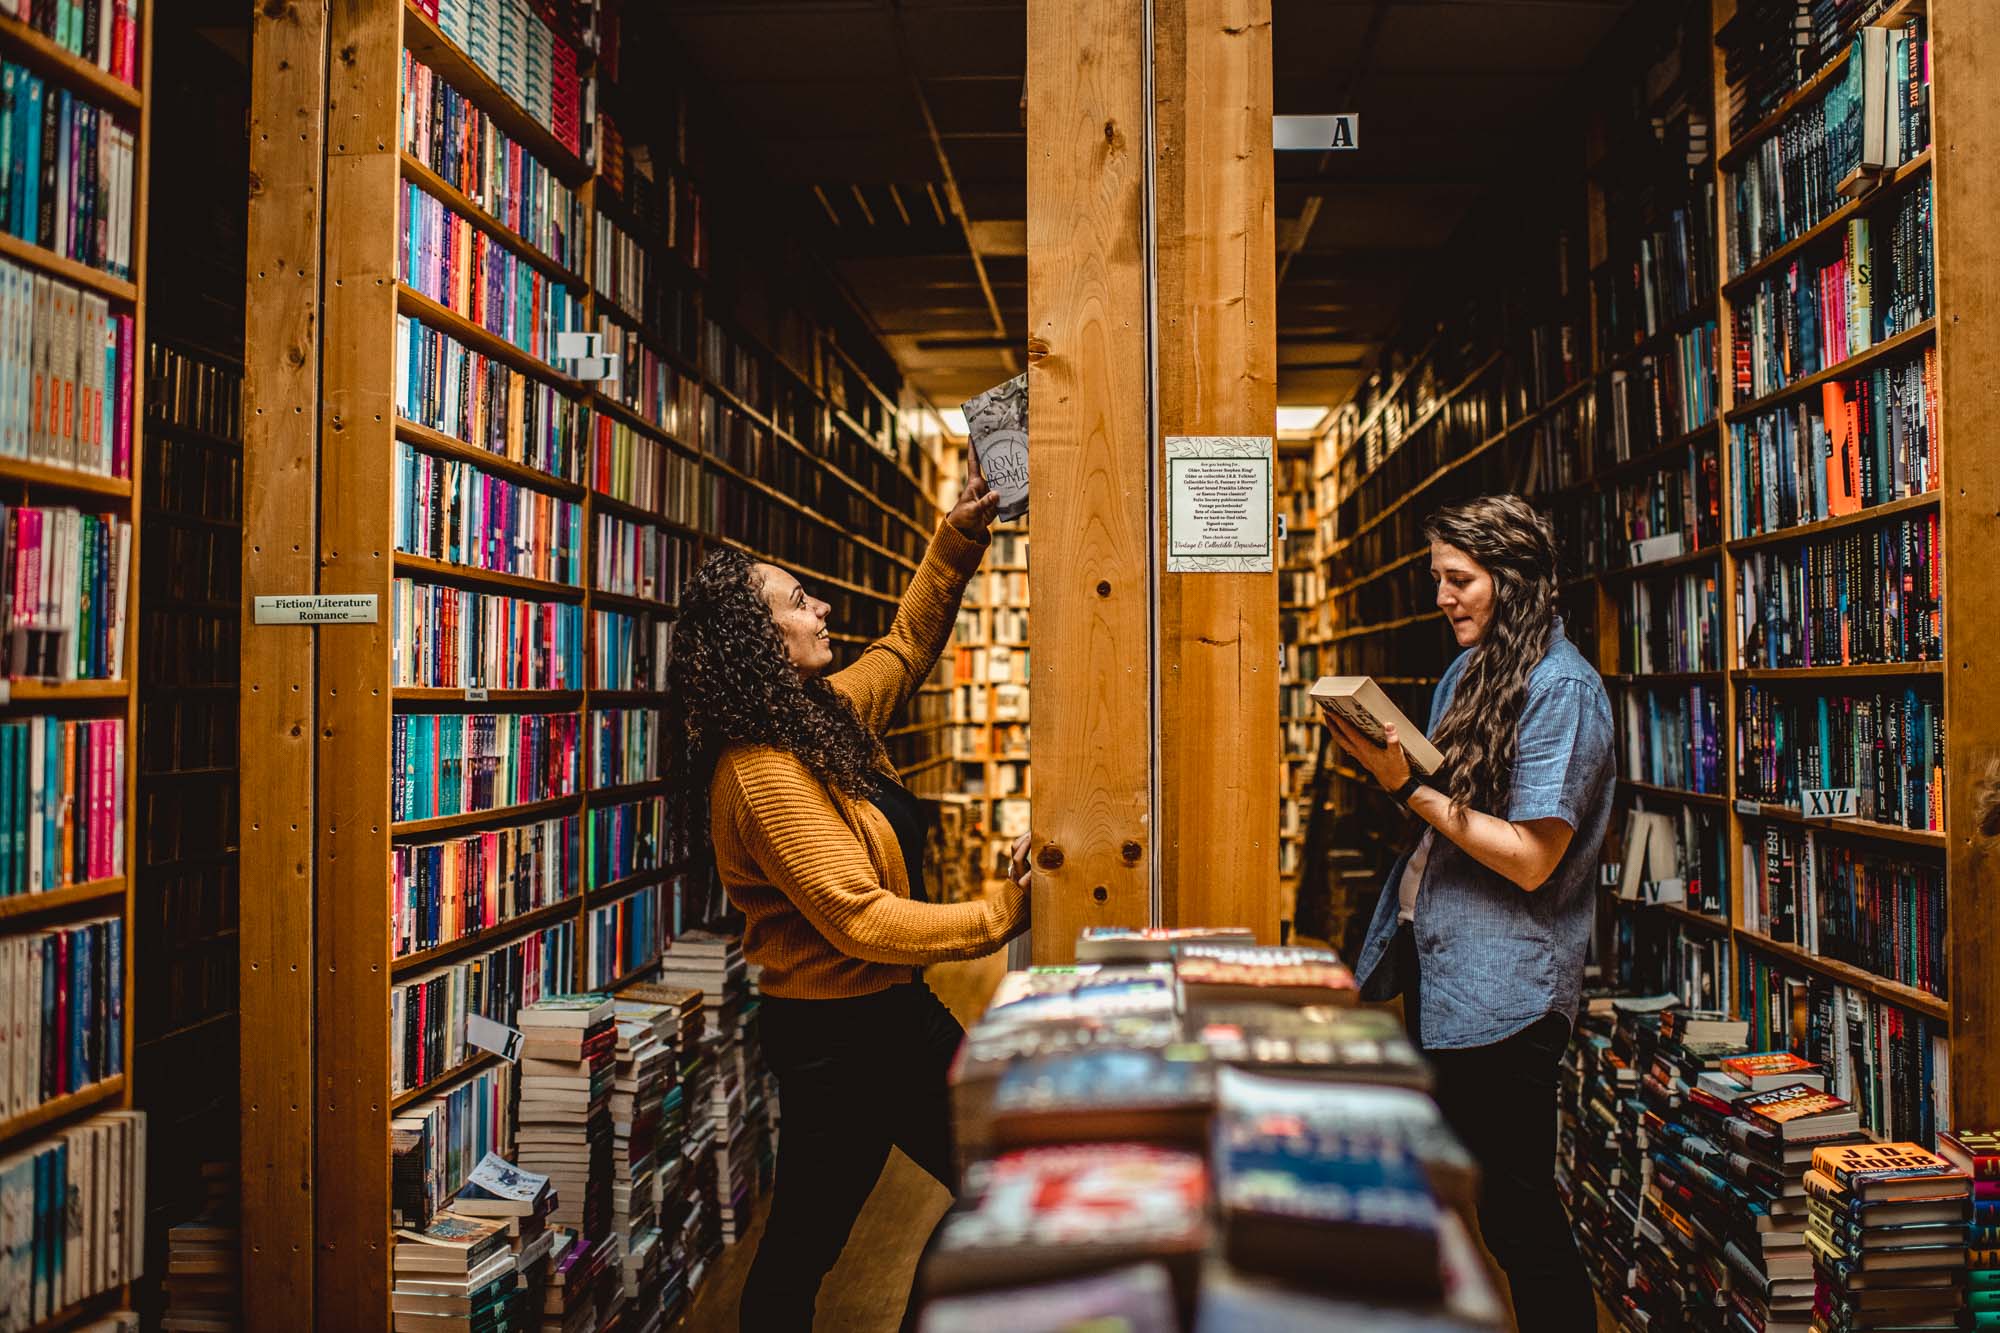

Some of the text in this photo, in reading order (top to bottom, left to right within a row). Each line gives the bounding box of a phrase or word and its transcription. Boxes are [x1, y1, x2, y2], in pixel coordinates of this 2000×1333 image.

[1910, 81, 1919, 108] DICE
[1331, 117, 1354, 147] A
[586, 336, 595, 358] I
[601, 358, 611, 379] J
[988, 450, 1024, 473] LOVE
[987, 468, 1029, 489] BOMB
[1633, 544, 1643, 562] T
[1902, 520, 1910, 568] STUART
[276, 598, 372, 610] Fiction/Literature
[299, 611, 348, 620] Romance
[1876, 694, 1886, 810] SIX FOUR
[1810, 790, 1850, 816] XYZ
[1648, 882, 1660, 902] V
[502, 1030, 520, 1061] K
[1841, 1156, 1937, 1168] ROBB
